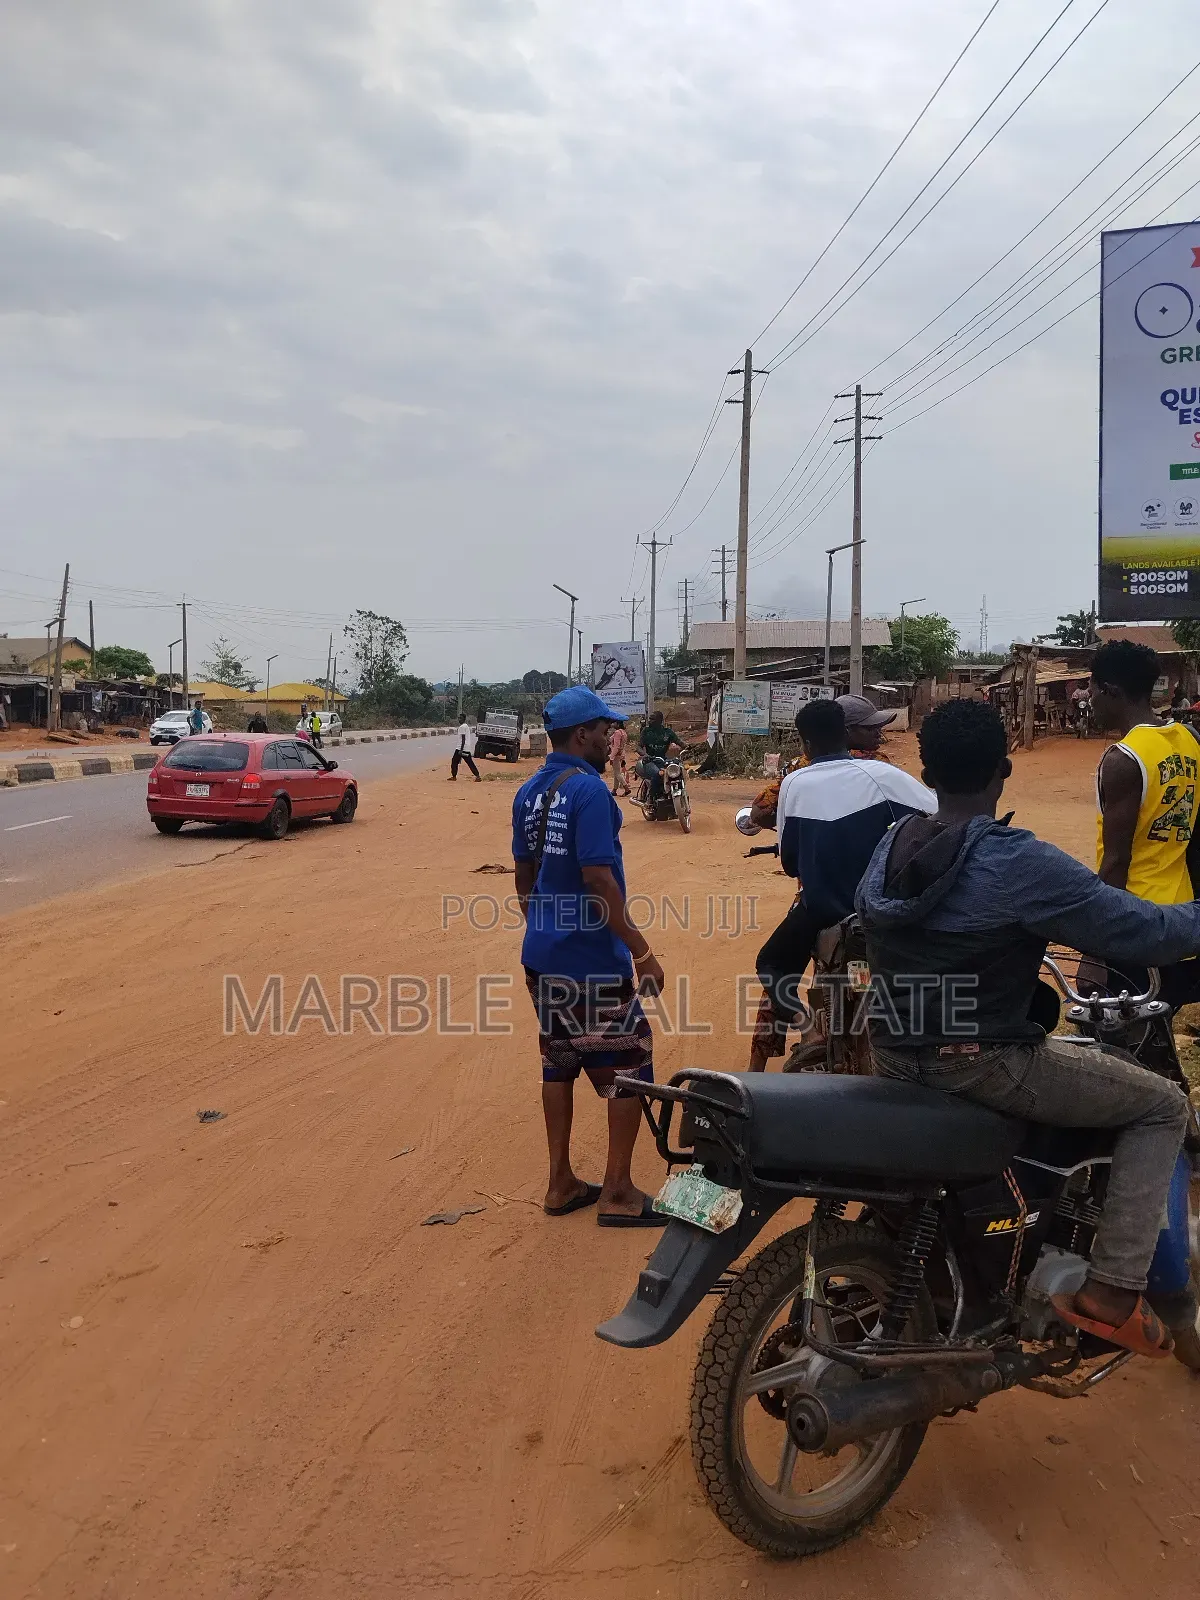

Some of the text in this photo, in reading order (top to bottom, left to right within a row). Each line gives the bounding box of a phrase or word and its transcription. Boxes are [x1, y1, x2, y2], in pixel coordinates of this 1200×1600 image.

[1160, 387, 1200, 411] QU
[1122, 562, 1150, 570] LANDS
[1151, 559, 1195, 569] AVAILABLE
[1130, 570, 1189, 583] 300SQM
[1130, 582, 1189, 595] 500SQM
[694, 1115, 711, 1129] TVS
